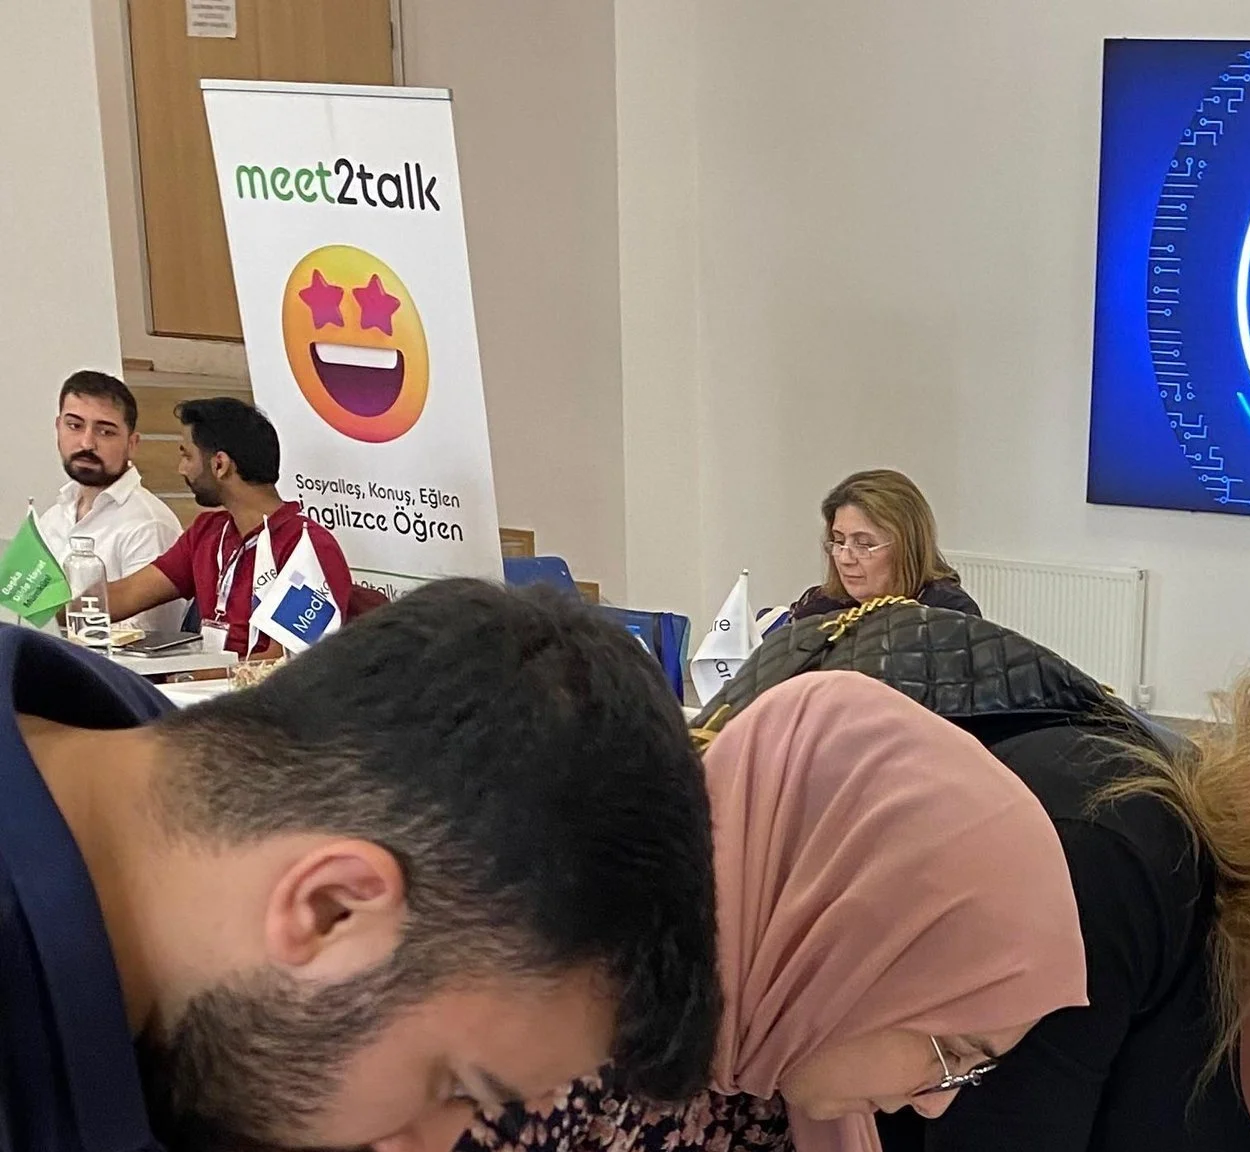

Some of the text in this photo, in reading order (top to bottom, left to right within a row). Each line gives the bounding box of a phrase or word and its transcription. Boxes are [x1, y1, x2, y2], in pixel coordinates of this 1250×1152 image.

[235, 158, 440, 212] meet2talk
[295, 473, 460, 509] Sosyalleş, Konuş, Eğlen
[393, 505, 463, 542] Öğren
